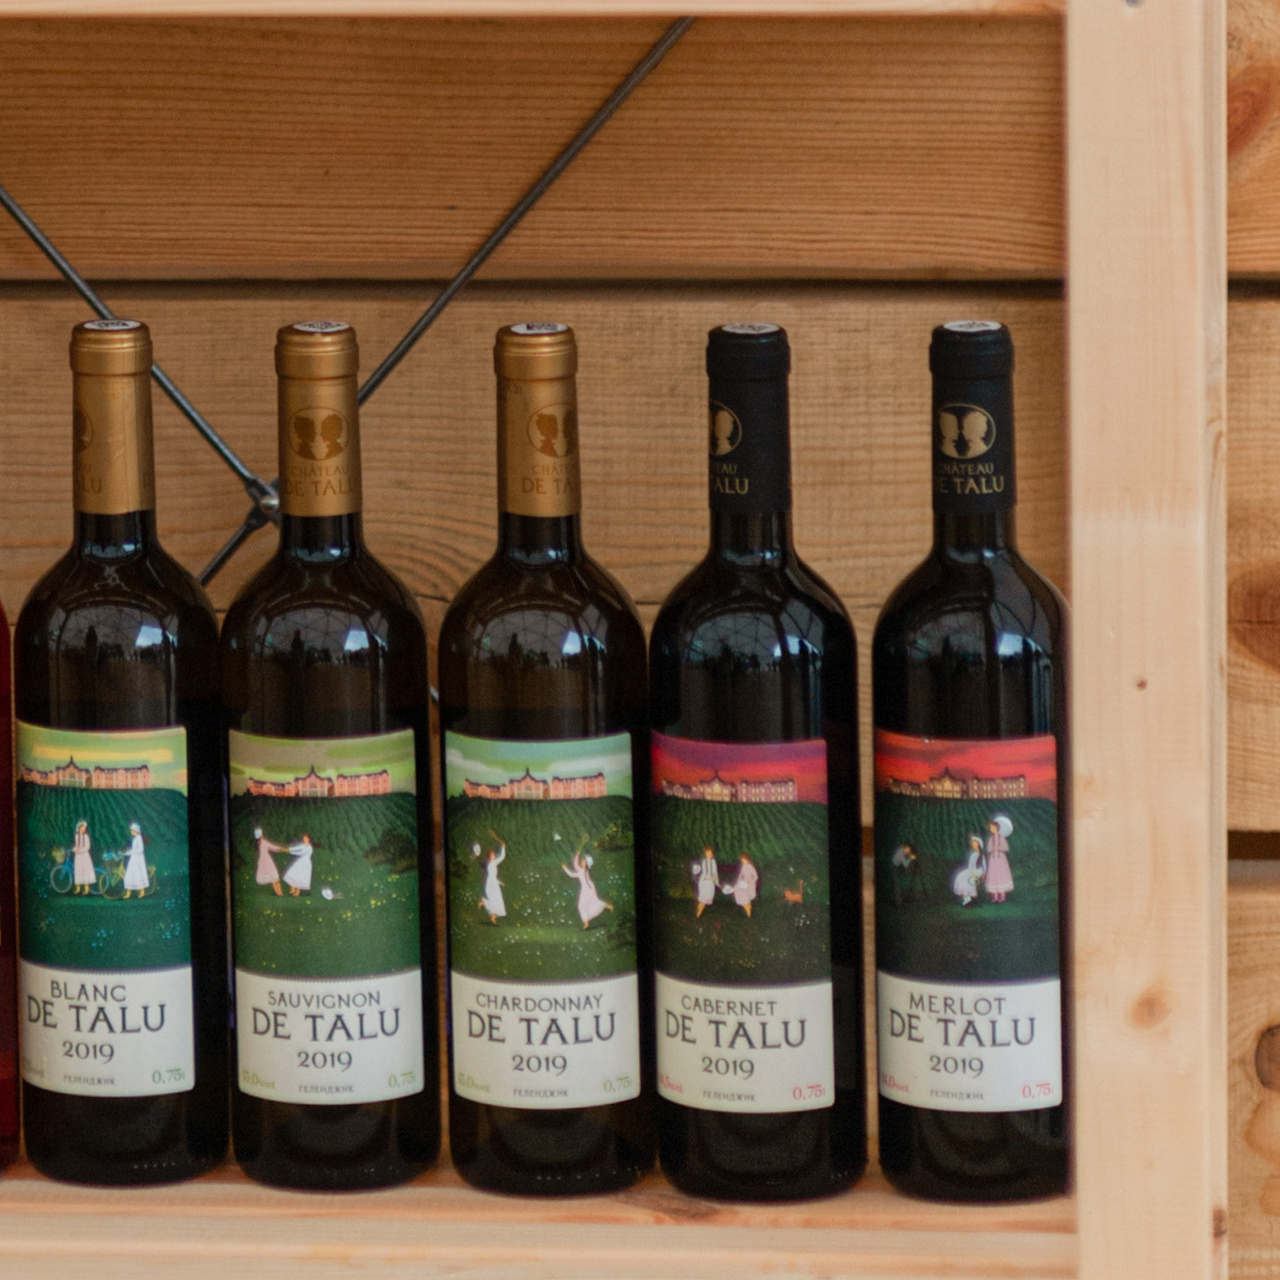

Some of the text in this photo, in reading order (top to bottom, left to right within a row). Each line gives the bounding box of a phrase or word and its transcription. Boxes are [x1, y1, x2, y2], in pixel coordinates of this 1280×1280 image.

[522, 477, 547, 495] DE
[714, 477, 749, 495] ALU
[953, 475, 1004, 495] TALU
[51, 980, 126, 1002] BLANC
[268, 991, 381, 1009] SAUVIGNON
[476, 992, 603, 1013] CHARDONNAY
[681, 995, 778, 1016] CABERNET
[909, 992, 1007, 1016] MERLOT
[27, 994, 166, 1034] DE TALU
[252, 1007, 400, 1041] DE TALU
[467, 1009, 616, 1046] DE TALU
[666, 1009, 807, 1050] DE TALU
[889, 1008, 1036, 1048] DE TALU
[62, 1040, 114, 1065] 2019
[297, 1051, 353, 1073] 2019
[512, 1054, 568, 1077] 2019
[701, 1056, 755, 1080] 2019
[929, 1055, 984, 1079] 2019
[63, 1075, 116, 1085] ГЕЛЕНДЖИК
[703, 1090, 756, 1102] ГЕЛЕНДЖИК
[930, 1089, 985, 1100] ГЕЛЕНДЖИК
